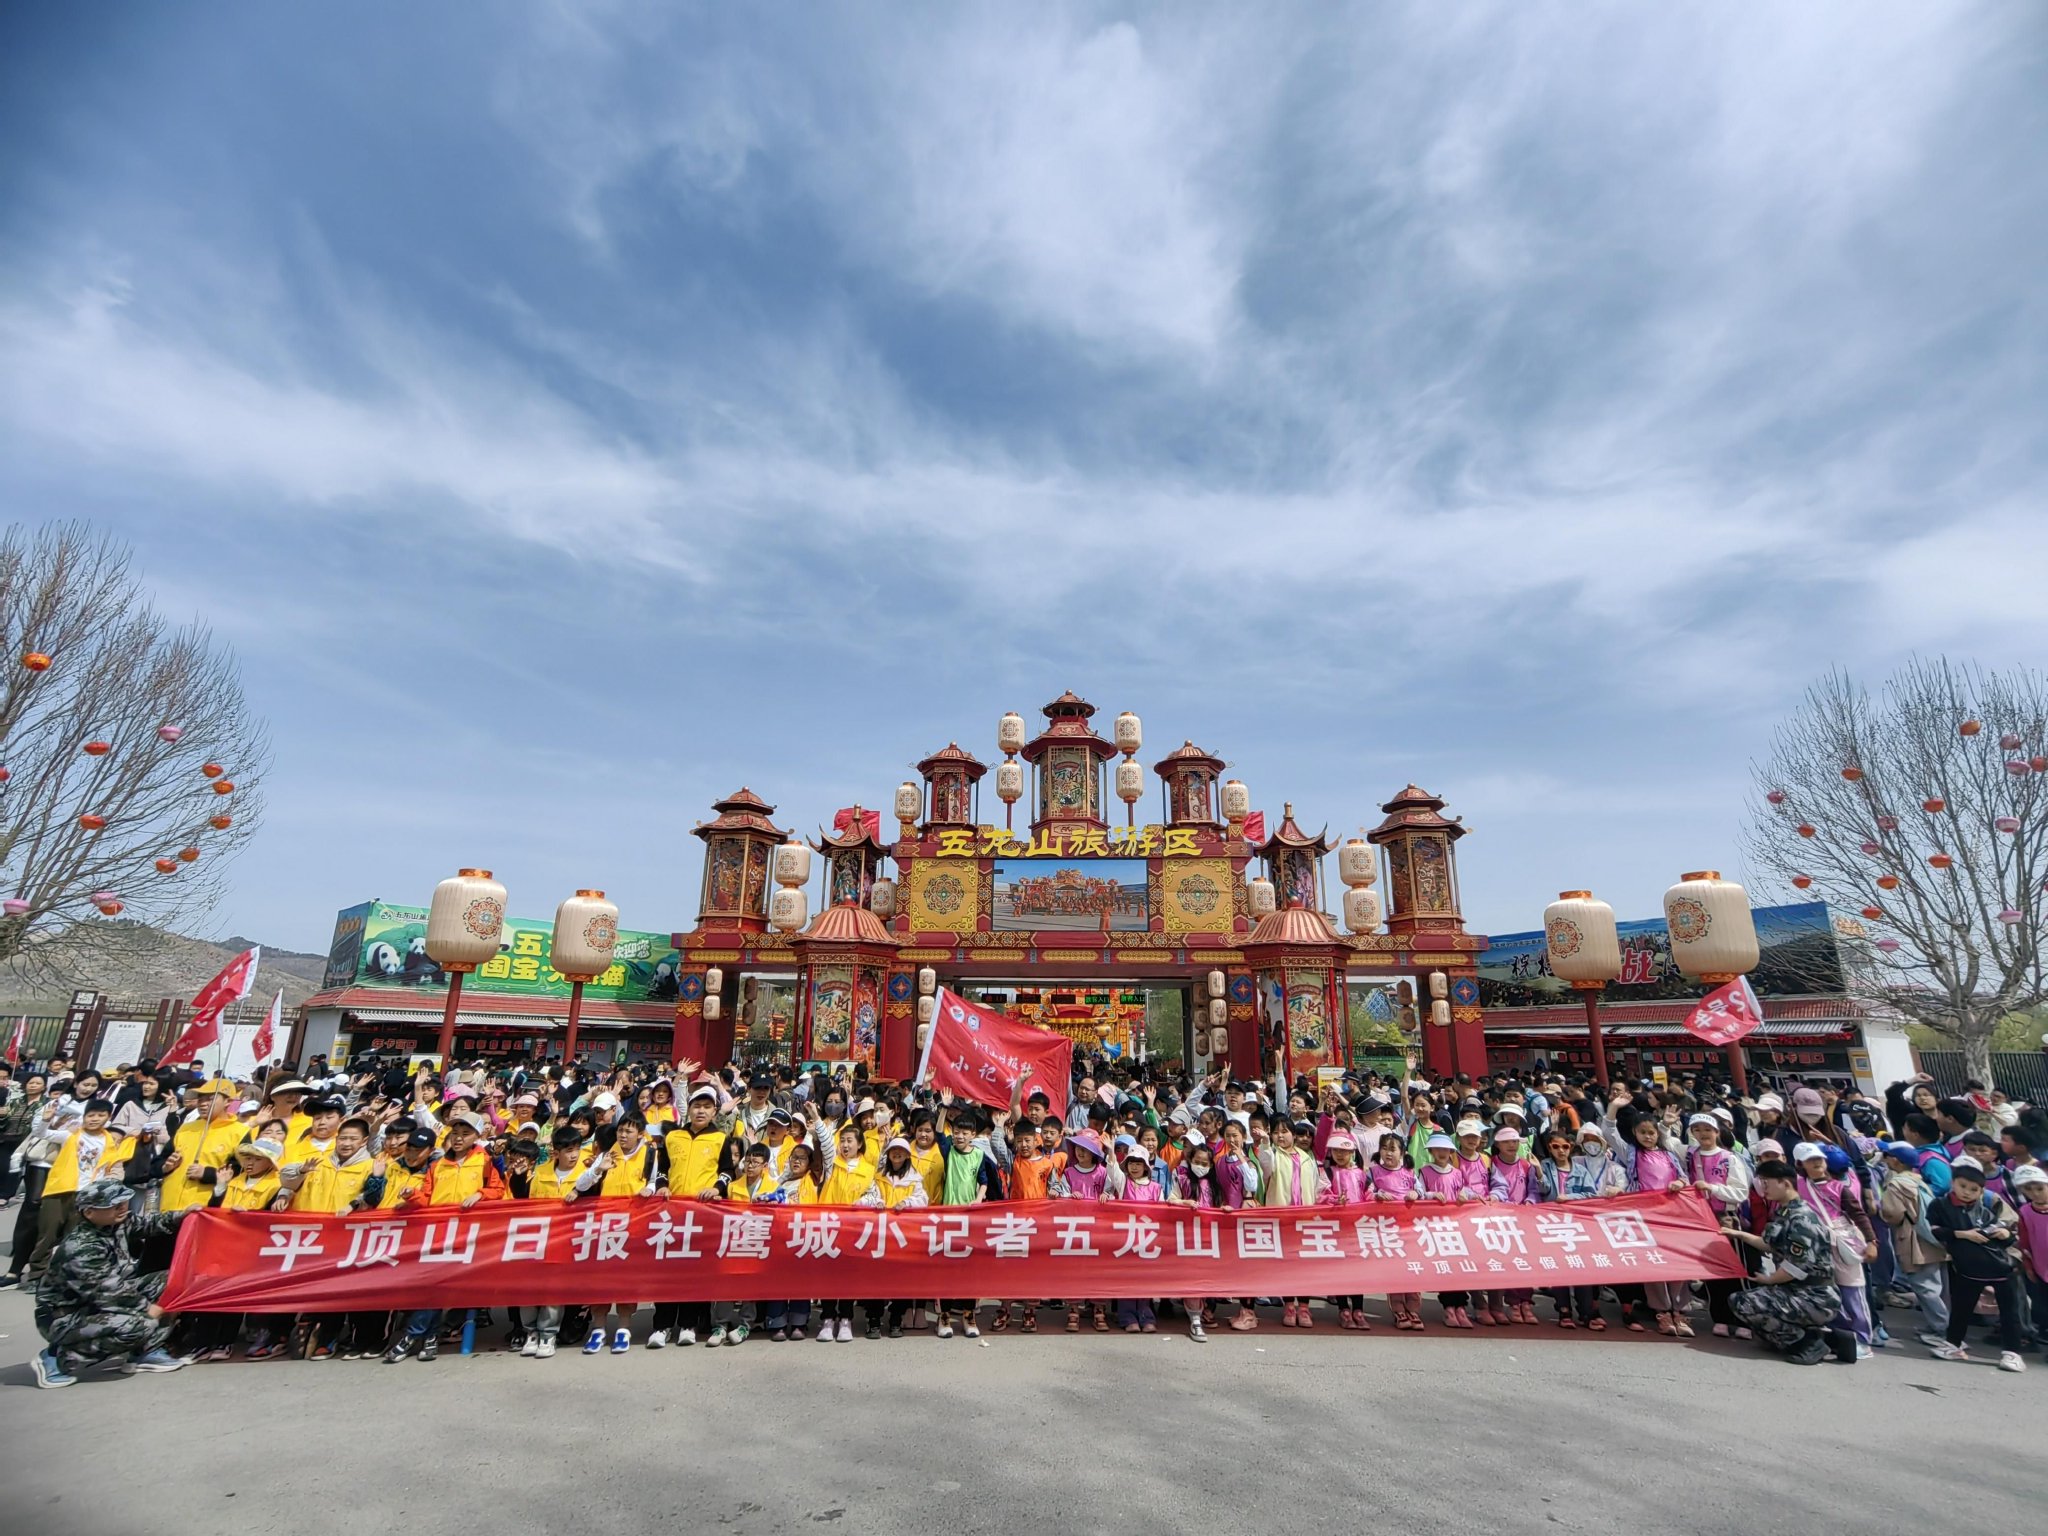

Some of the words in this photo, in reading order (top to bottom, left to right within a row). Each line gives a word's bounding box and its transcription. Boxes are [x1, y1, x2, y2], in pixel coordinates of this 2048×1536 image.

[936, 826, 1203, 857] 五龙山旅游区
[480, 956, 626, 986] 国宝·猫
[259, 1209, 1657, 1272] 平顶山日报社鹰城小记者五龙山国宝熊猫研学团
[1407, 1249, 1668, 1276] 平顶山金色假期旅行社
